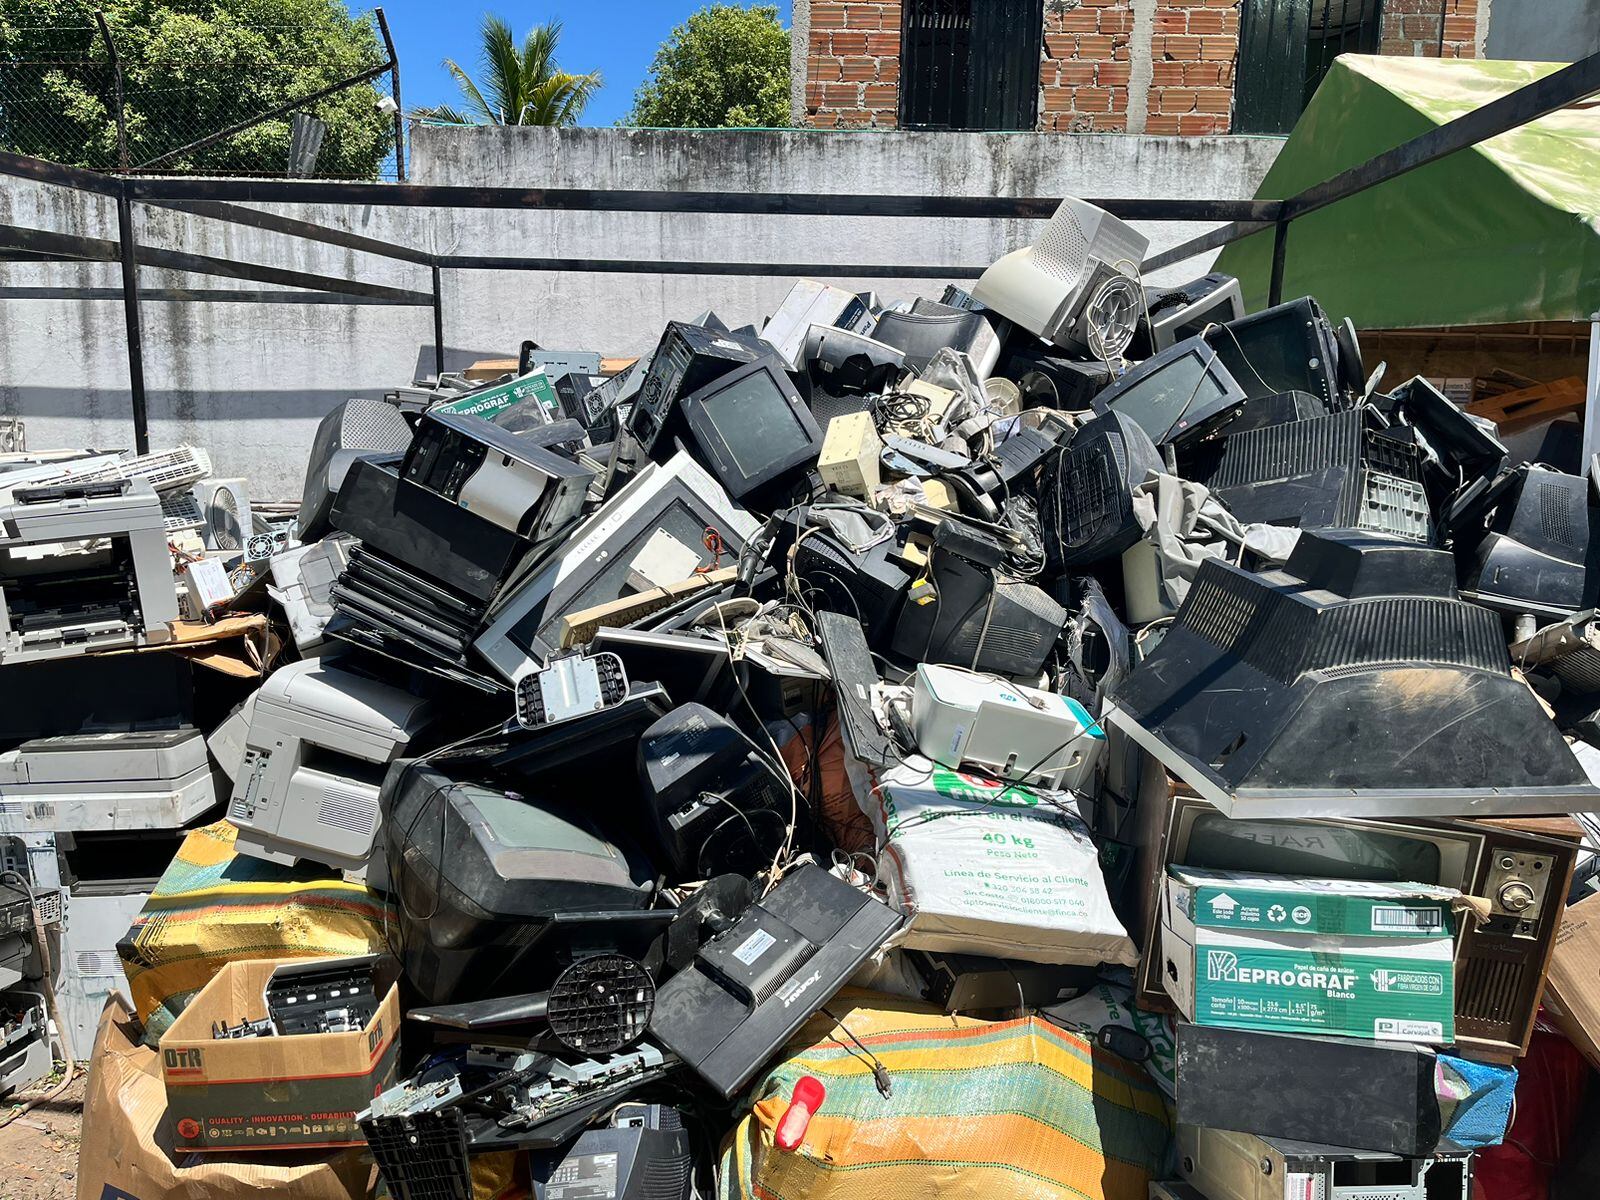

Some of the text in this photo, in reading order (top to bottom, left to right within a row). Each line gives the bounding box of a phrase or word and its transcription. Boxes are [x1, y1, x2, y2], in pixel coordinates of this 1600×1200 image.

[441, 395, 510, 415] PROGRAF
[949, 787, 1029, 805] FINCA
[988, 812, 1006, 821] en
[1010, 811, 1023, 822] el
[983, 833, 1035, 849] 40 kg
[986, 848, 1039, 859] Peso Neto
[977, 870, 991, 878] de
[994, 872, 1040, 883] Servicio
[1042, 875, 1052, 884] al
[1054, 875, 1089, 888] Cliente
[1208, 950, 1356, 990] REPROGRAF
[1293, 963, 1309, 971] Papel
[1397, 973, 1440, 985] FABRICADOS CON
[1326, 989, 1356, 999] Blanco
[1402, 1028, 1430, 1036] Carvajal
[208, 1116, 244, 1125] QUALITY
[251, 1114, 304, 1124] INNOVATION
